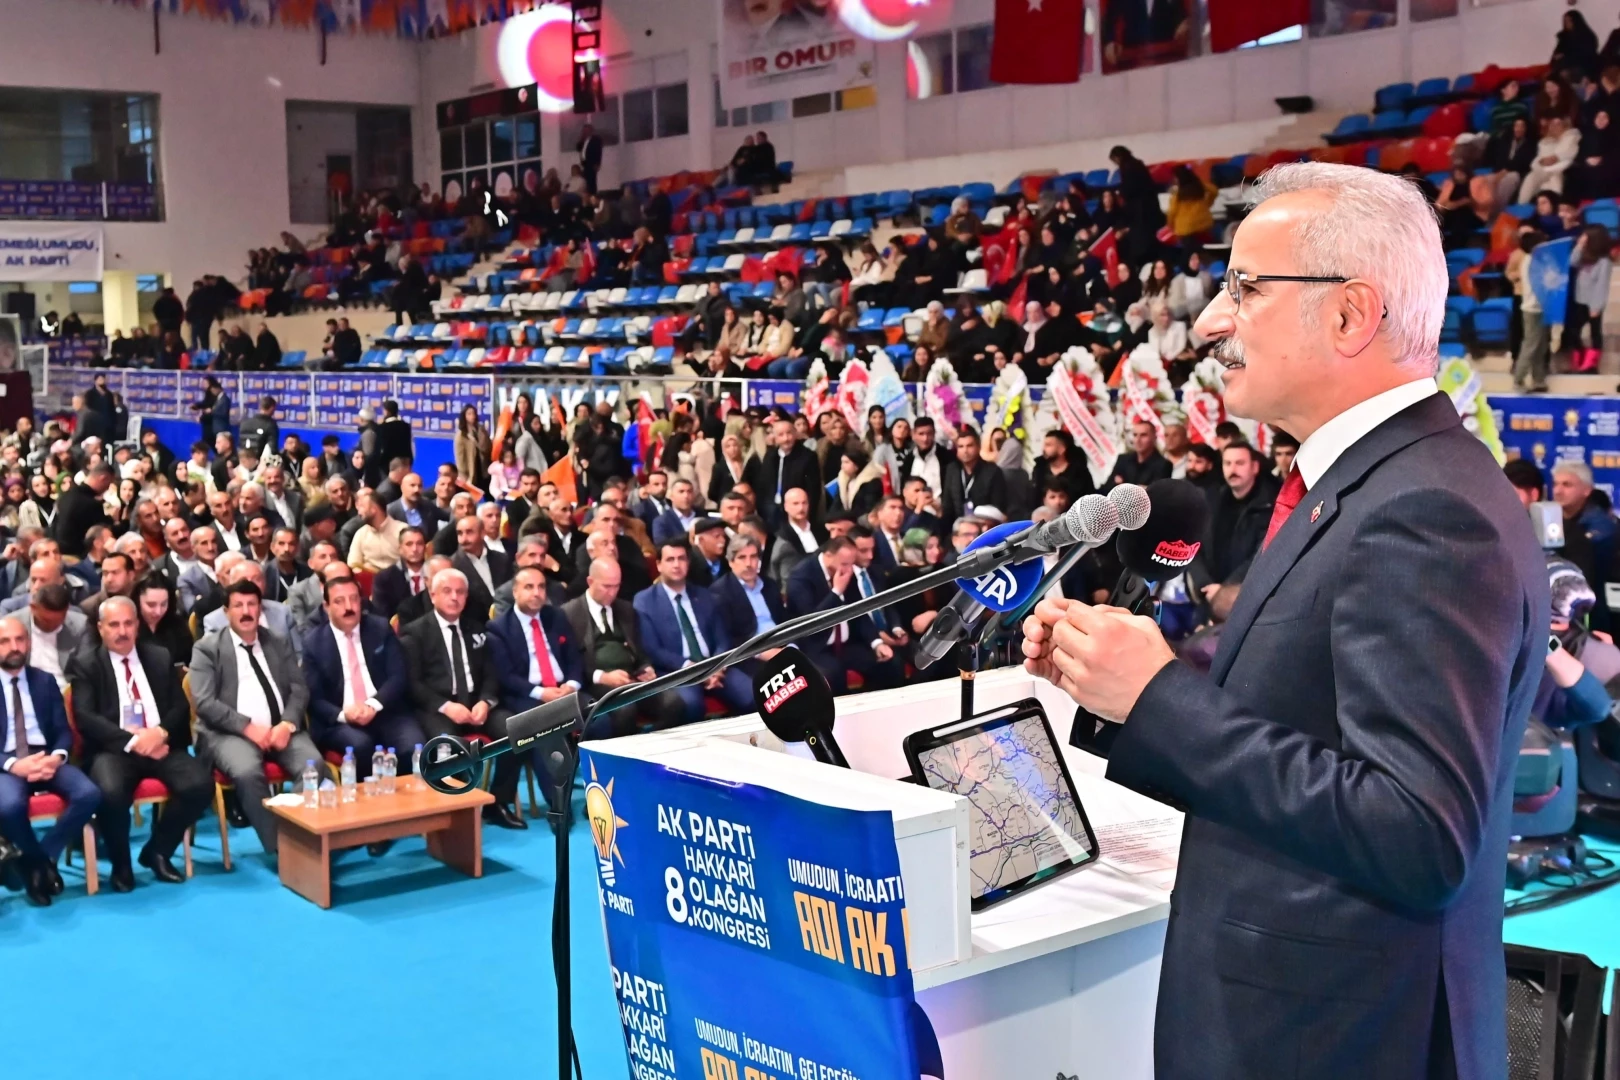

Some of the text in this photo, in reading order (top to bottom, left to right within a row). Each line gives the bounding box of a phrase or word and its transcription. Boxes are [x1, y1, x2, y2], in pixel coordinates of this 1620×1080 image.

[1159, 546, 1188, 558] HABER
[759, 664, 796, 699] TRT
[765, 678, 805, 711] HABER
[658, 803, 687, 840] AK
[683, 844, 755, 890] HAKKARİ
[788, 858, 844, 899] UMUDUN,
[689, 876, 766, 923] OLAĞAN
[793, 890, 845, 964] ADI
[845, 905, 896, 977] AK
[694, 1017, 743, 1060] UMUDUN,
[742, 1032, 798, 1080] İCRAATIN,
